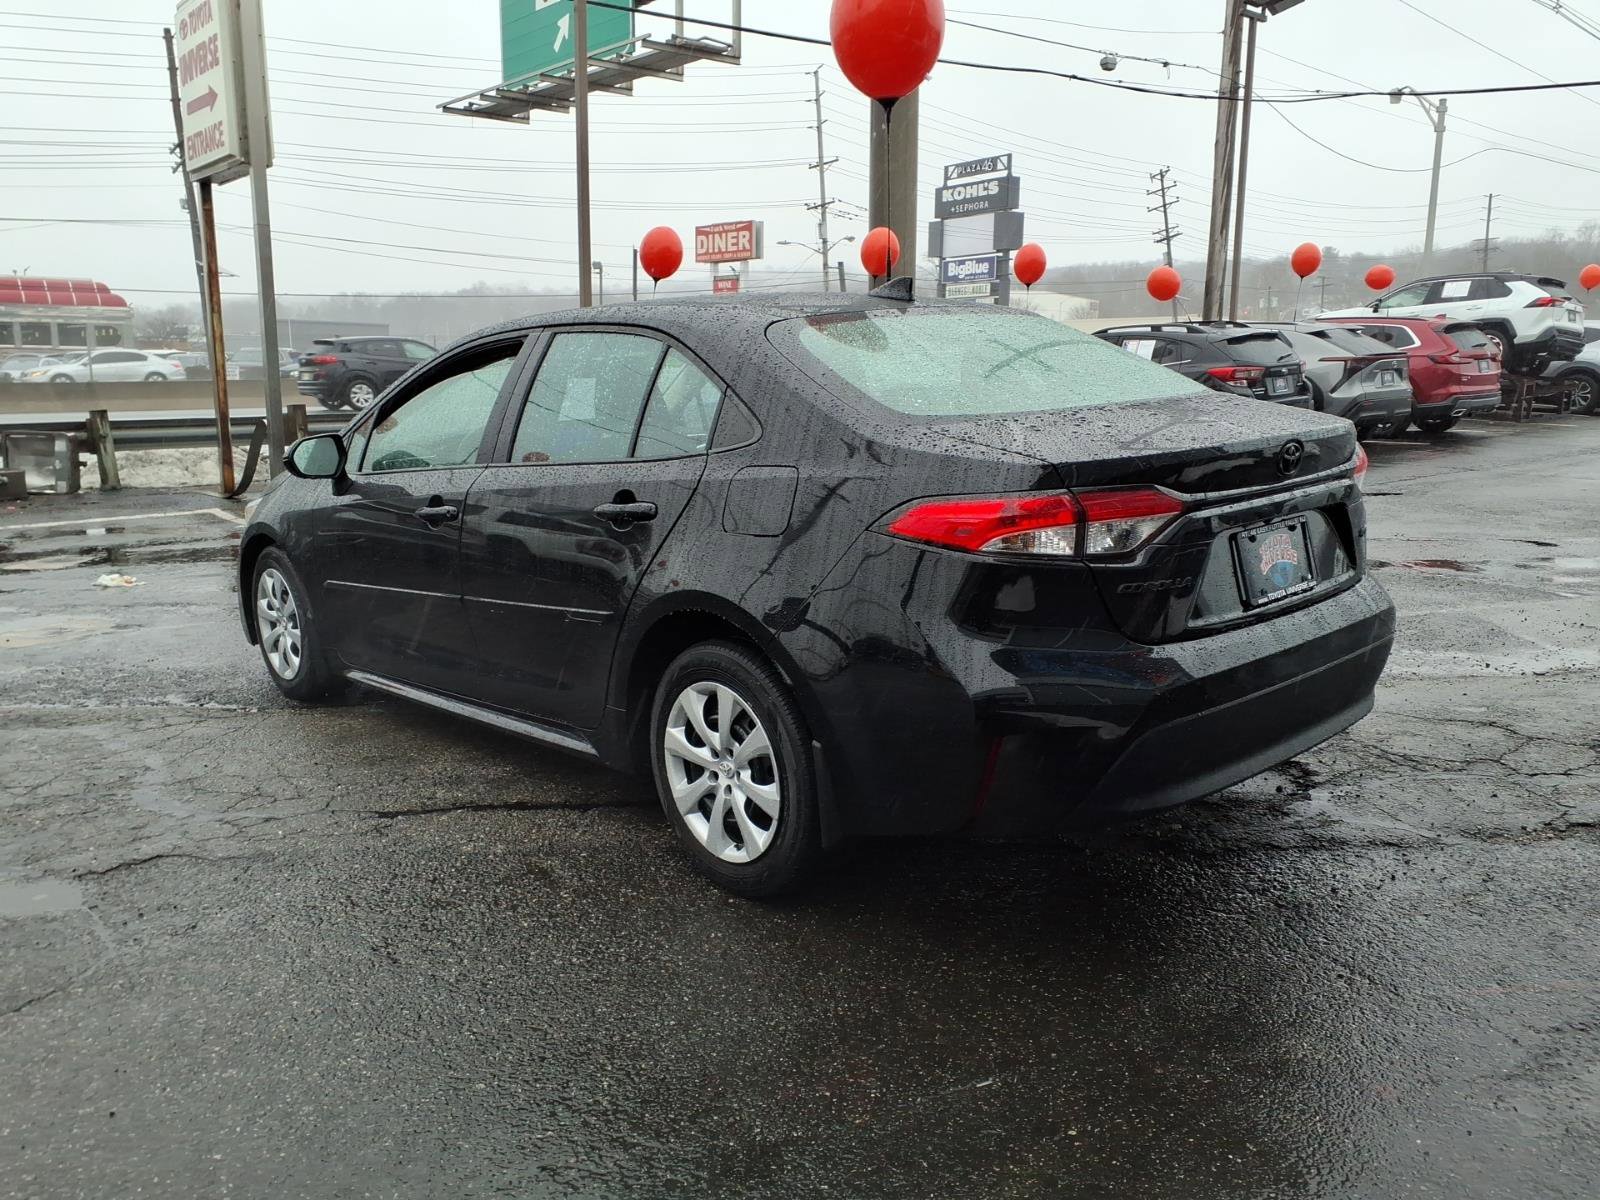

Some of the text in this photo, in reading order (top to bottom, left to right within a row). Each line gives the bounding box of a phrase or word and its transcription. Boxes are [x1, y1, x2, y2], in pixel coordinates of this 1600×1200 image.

[188, 0, 213, 36] TOYOTA
[179, 33, 220, 87] UNIVERSE
[186, 120, 225, 161] ENTRANCE
[958, 159, 993, 174] PLAZA 46
[942, 181, 999, 202] KOHL'S
[697, 231, 750, 254] DINER
[948, 260, 989, 278] BigBlue
